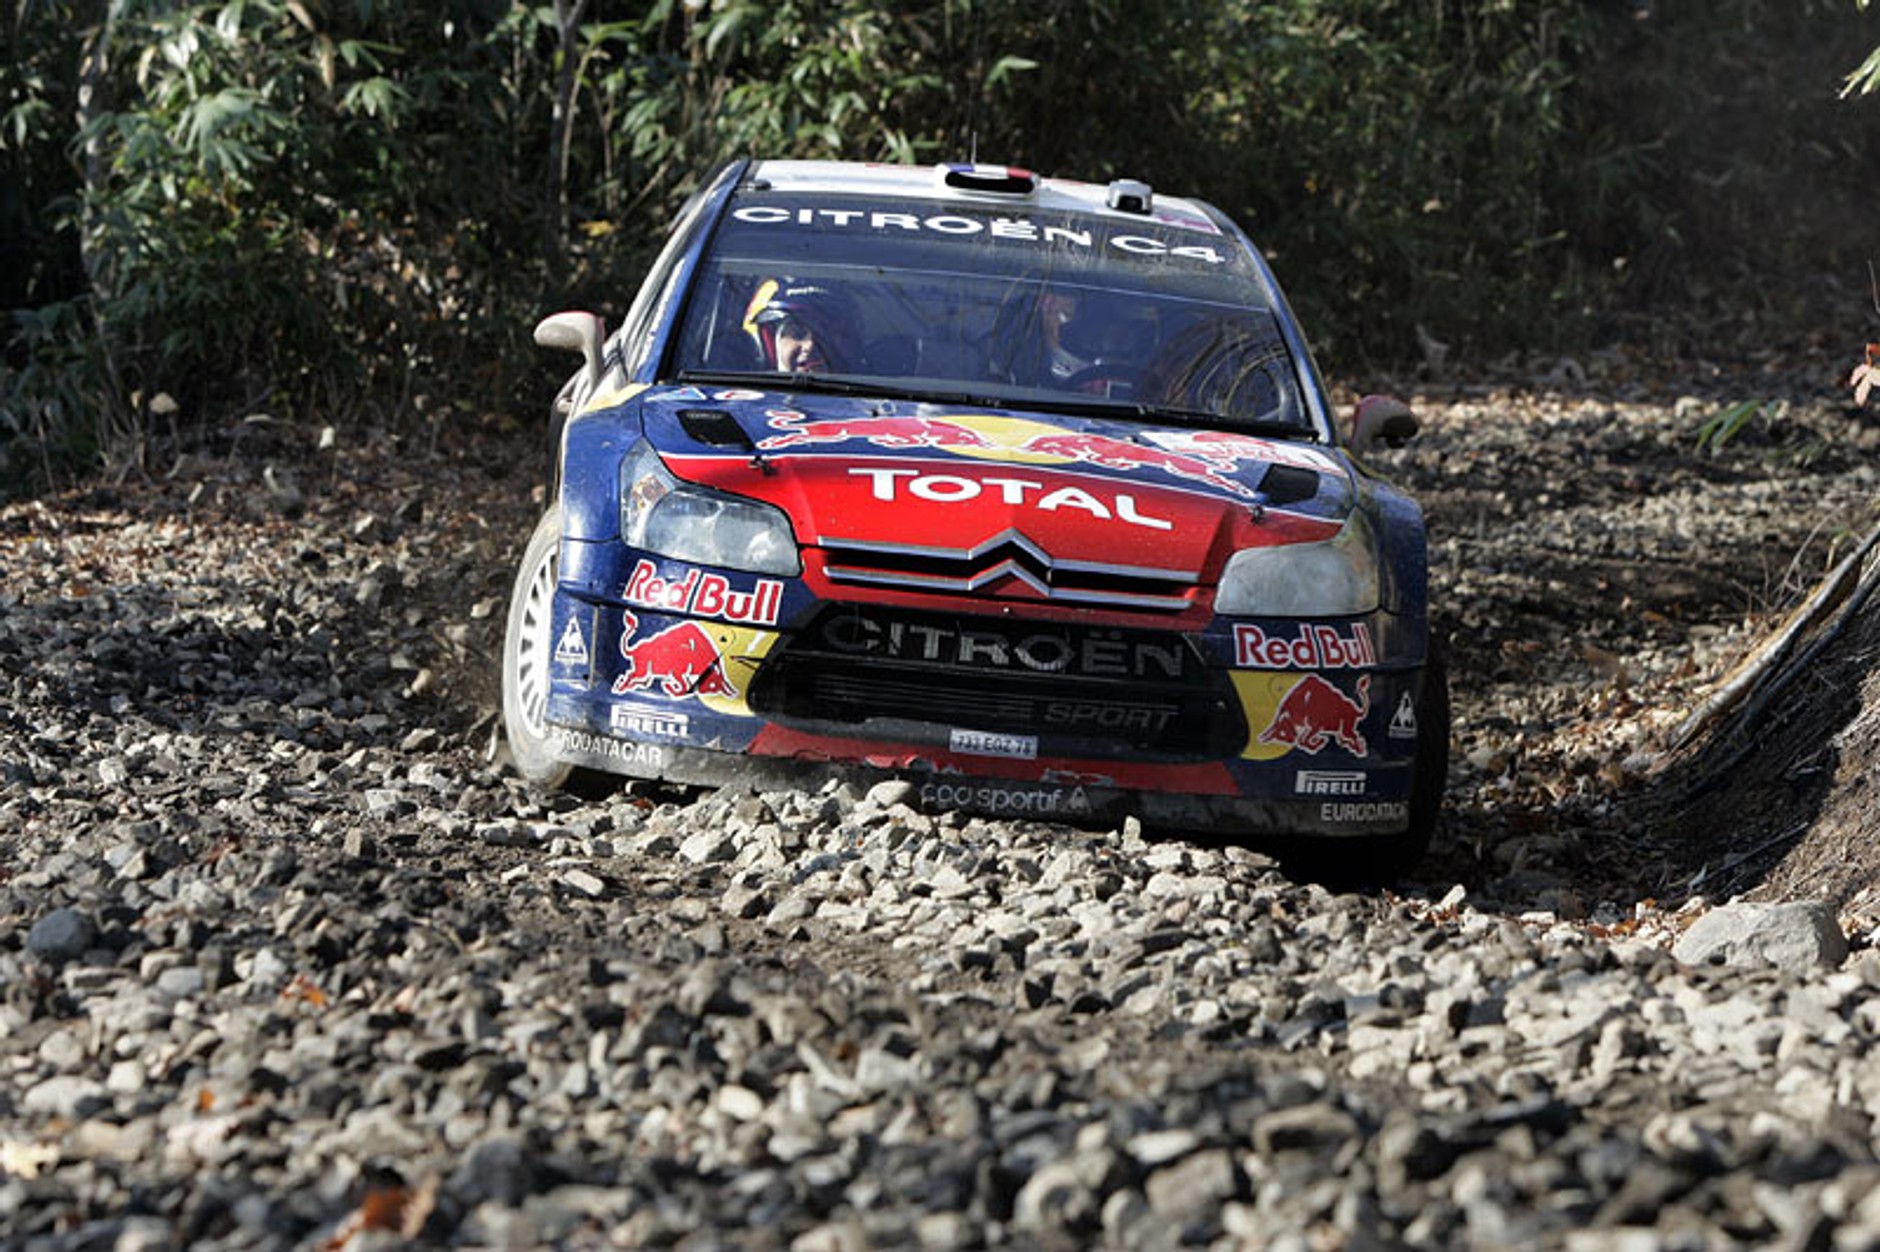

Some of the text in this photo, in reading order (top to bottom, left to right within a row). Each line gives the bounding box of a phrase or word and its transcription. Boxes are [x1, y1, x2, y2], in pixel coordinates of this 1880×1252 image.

[733, 206, 1226, 264] CITROËN C4
[848, 467, 1173, 530] TOTAL
[623, 559, 784, 625] Red Bull
[823, 614, 1184, 677] CITROËN
[1233, 623, 1377, 669] Red Bull
[610, 704, 690, 738] PIRELLI
[1044, 703, 1181, 731] SPORT
[1294, 769, 1367, 795] PIRELLI
